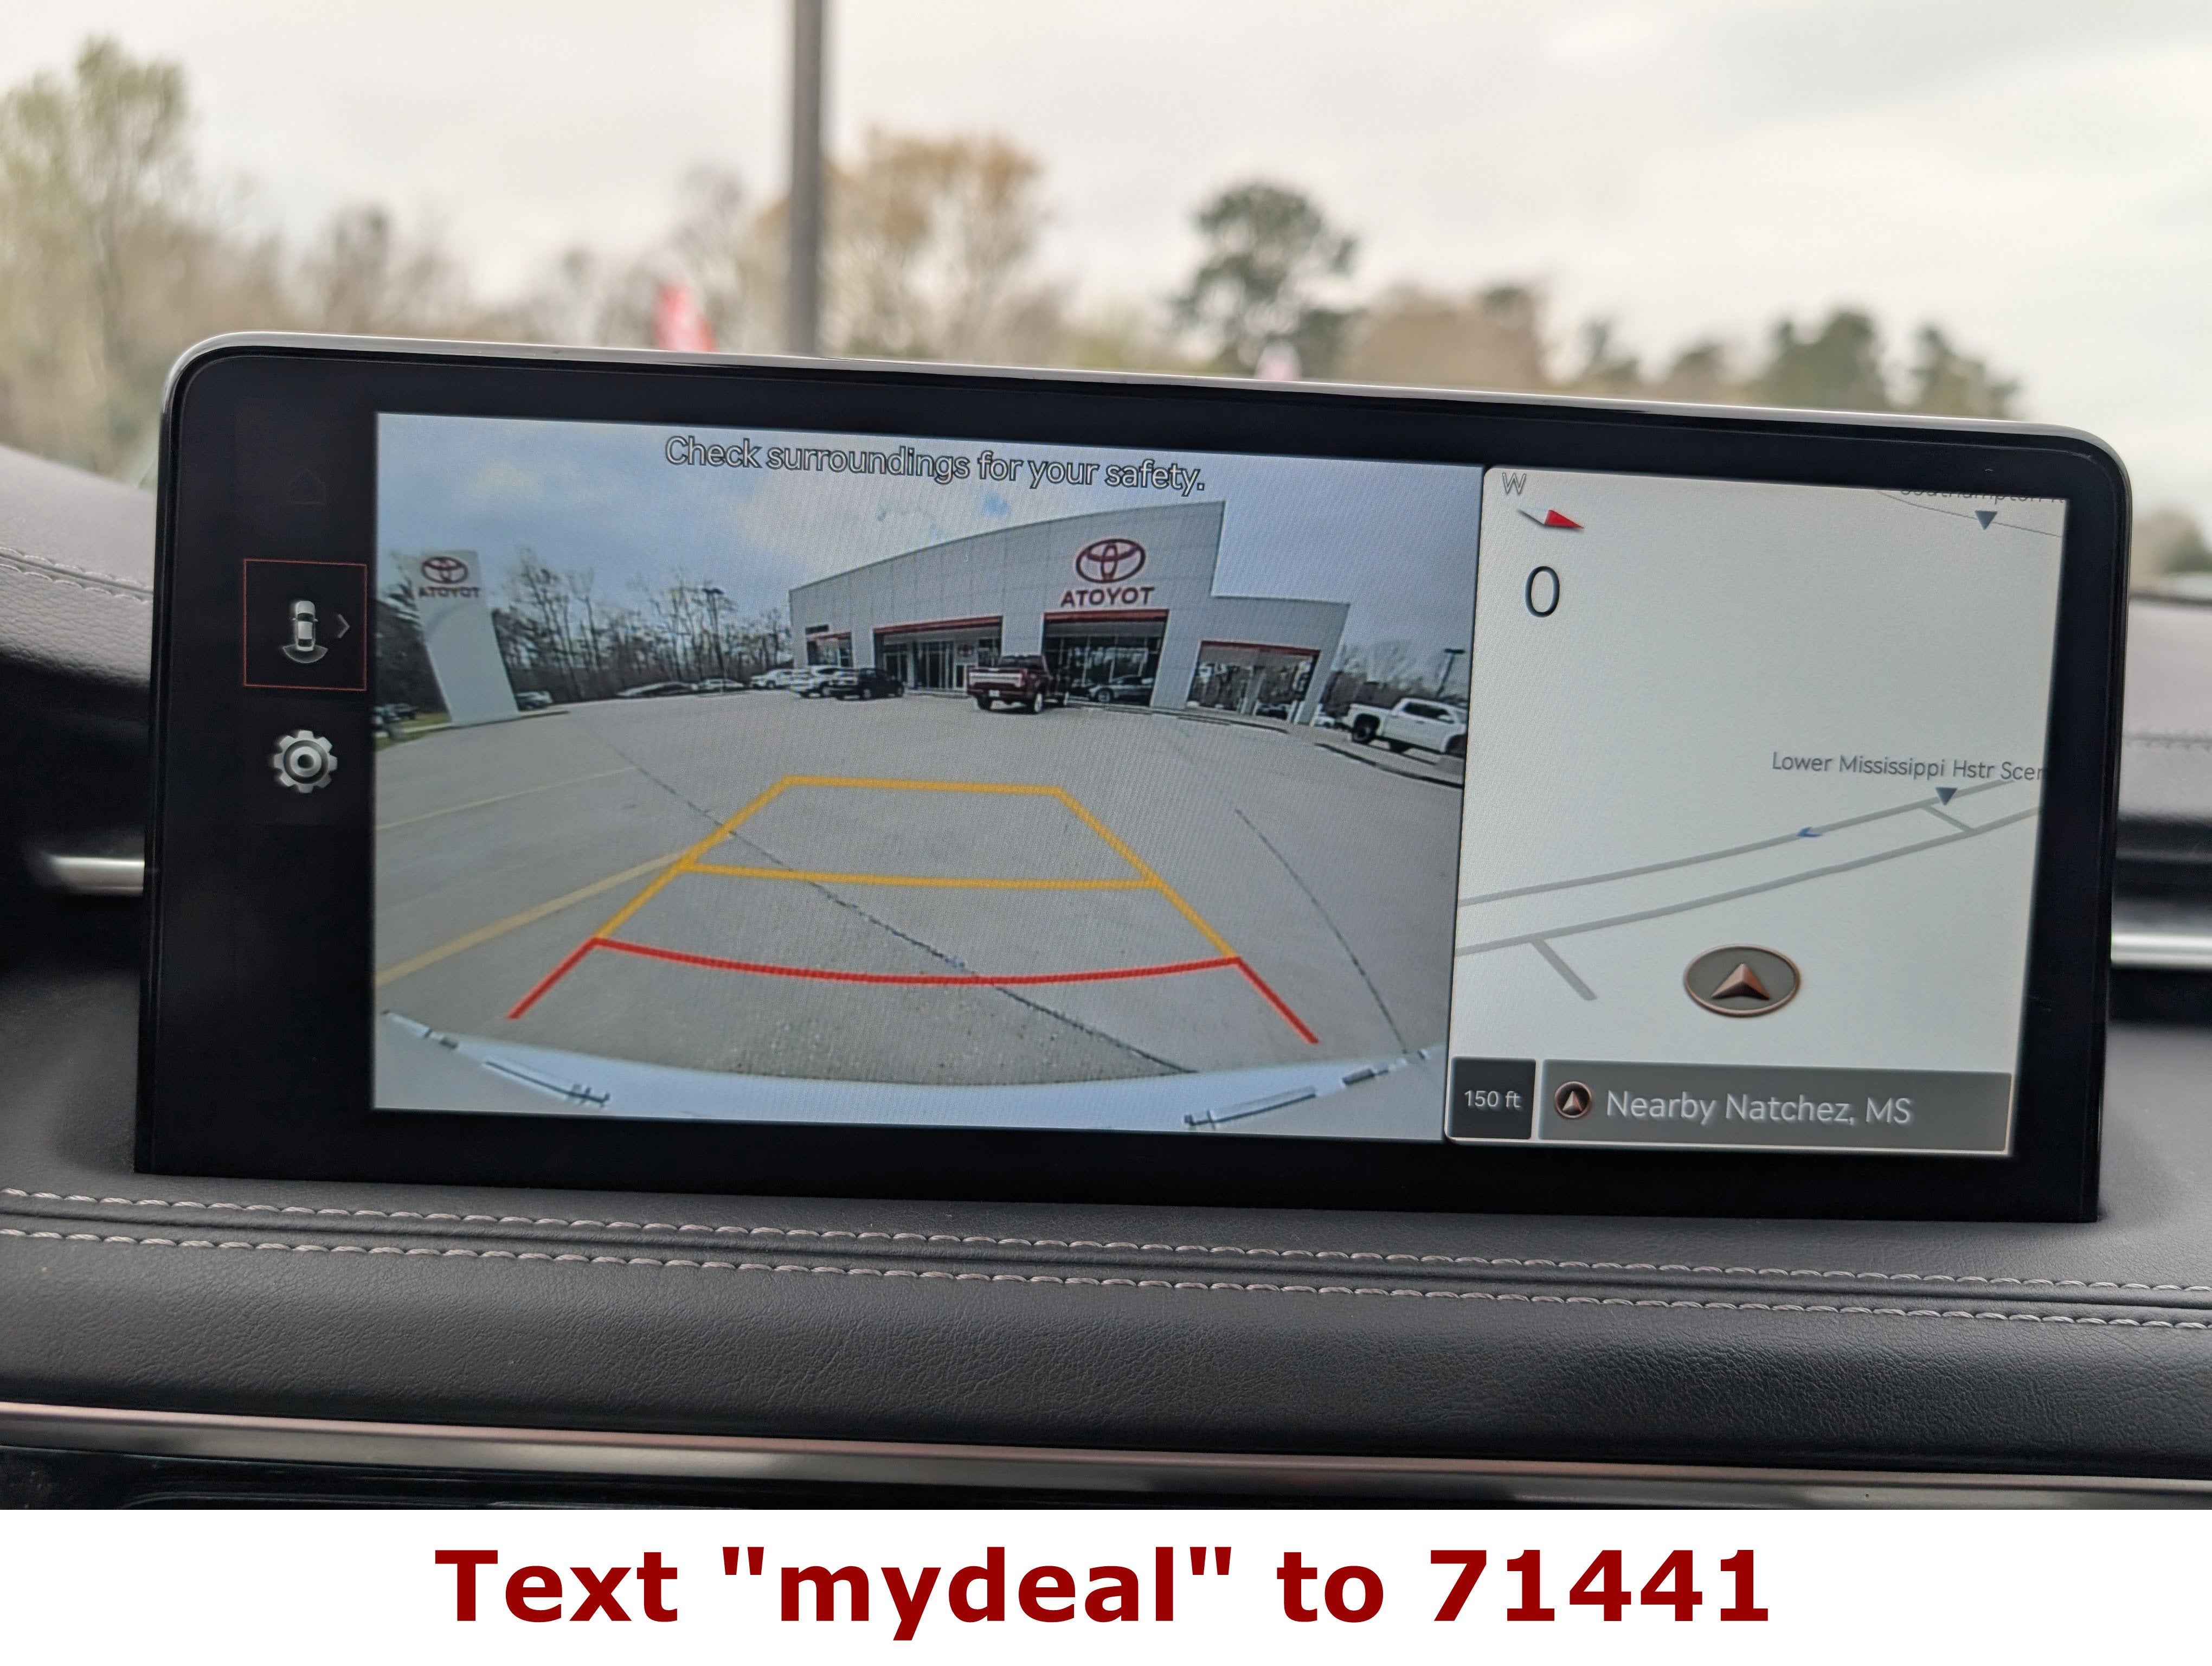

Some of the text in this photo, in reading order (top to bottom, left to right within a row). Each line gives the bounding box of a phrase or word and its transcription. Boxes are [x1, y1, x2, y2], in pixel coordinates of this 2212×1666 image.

[665, 435, 1205, 497] Check surroundings for your safety.
[1501, 472, 1527, 496] W
[1525, 566, 1560, 618] 0
[1772, 752, 1832, 771] Lower
[1839, 754, 1945, 780] Mississippi
[1953, 760, 1995, 779] Hstr
[1464, 1090, 1520, 1108] 150 ft
[1606, 1090, 1912, 1125] Nearby Natchez, MS
